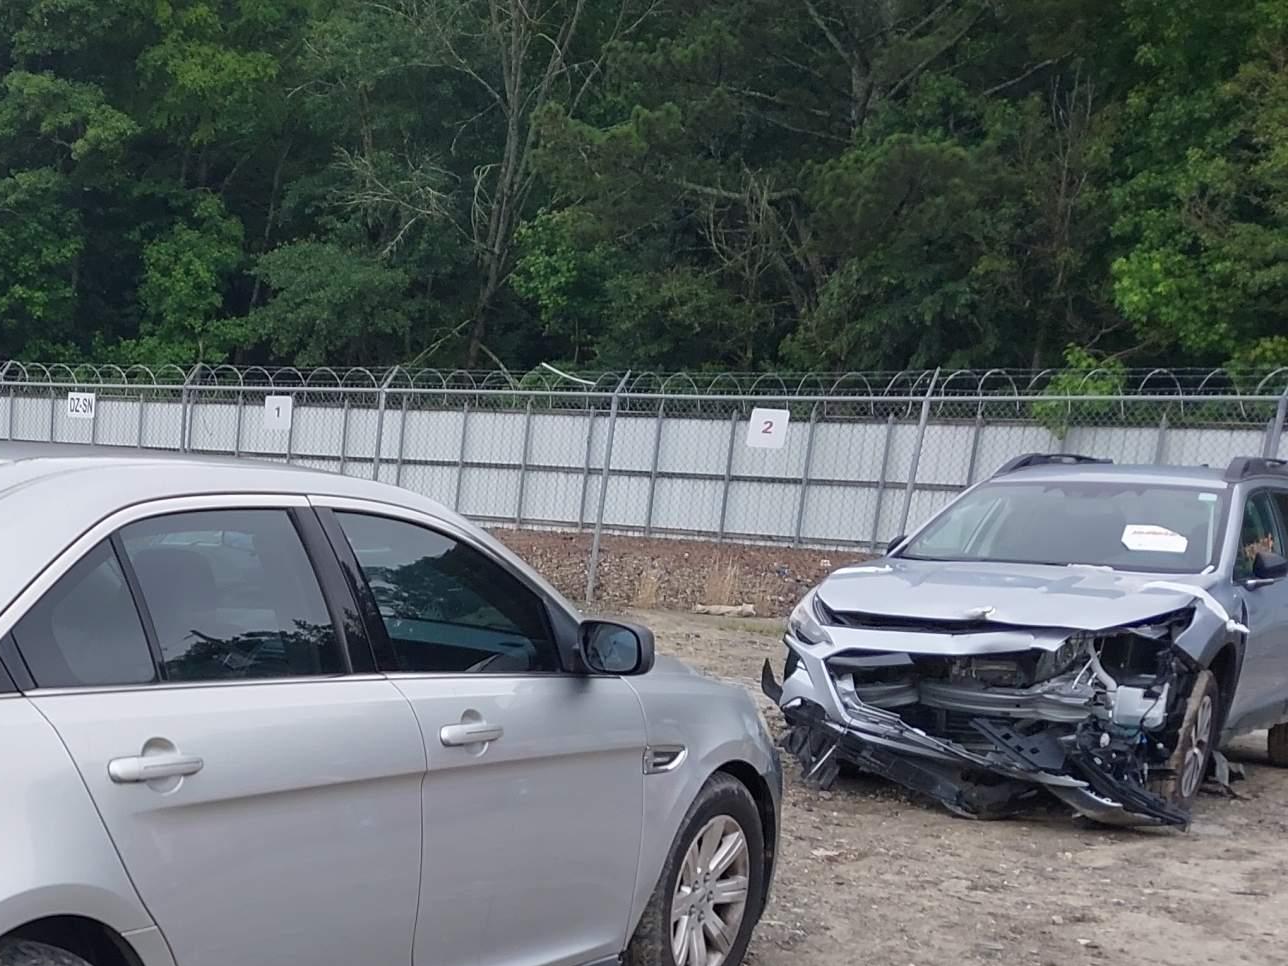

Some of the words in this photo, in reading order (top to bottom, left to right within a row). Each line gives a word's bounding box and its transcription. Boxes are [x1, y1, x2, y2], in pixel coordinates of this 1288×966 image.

[69, 397, 93, 413] DZ-SN
[275, 406, 280, 417] 1
[762, 420, 774, 434] 2
